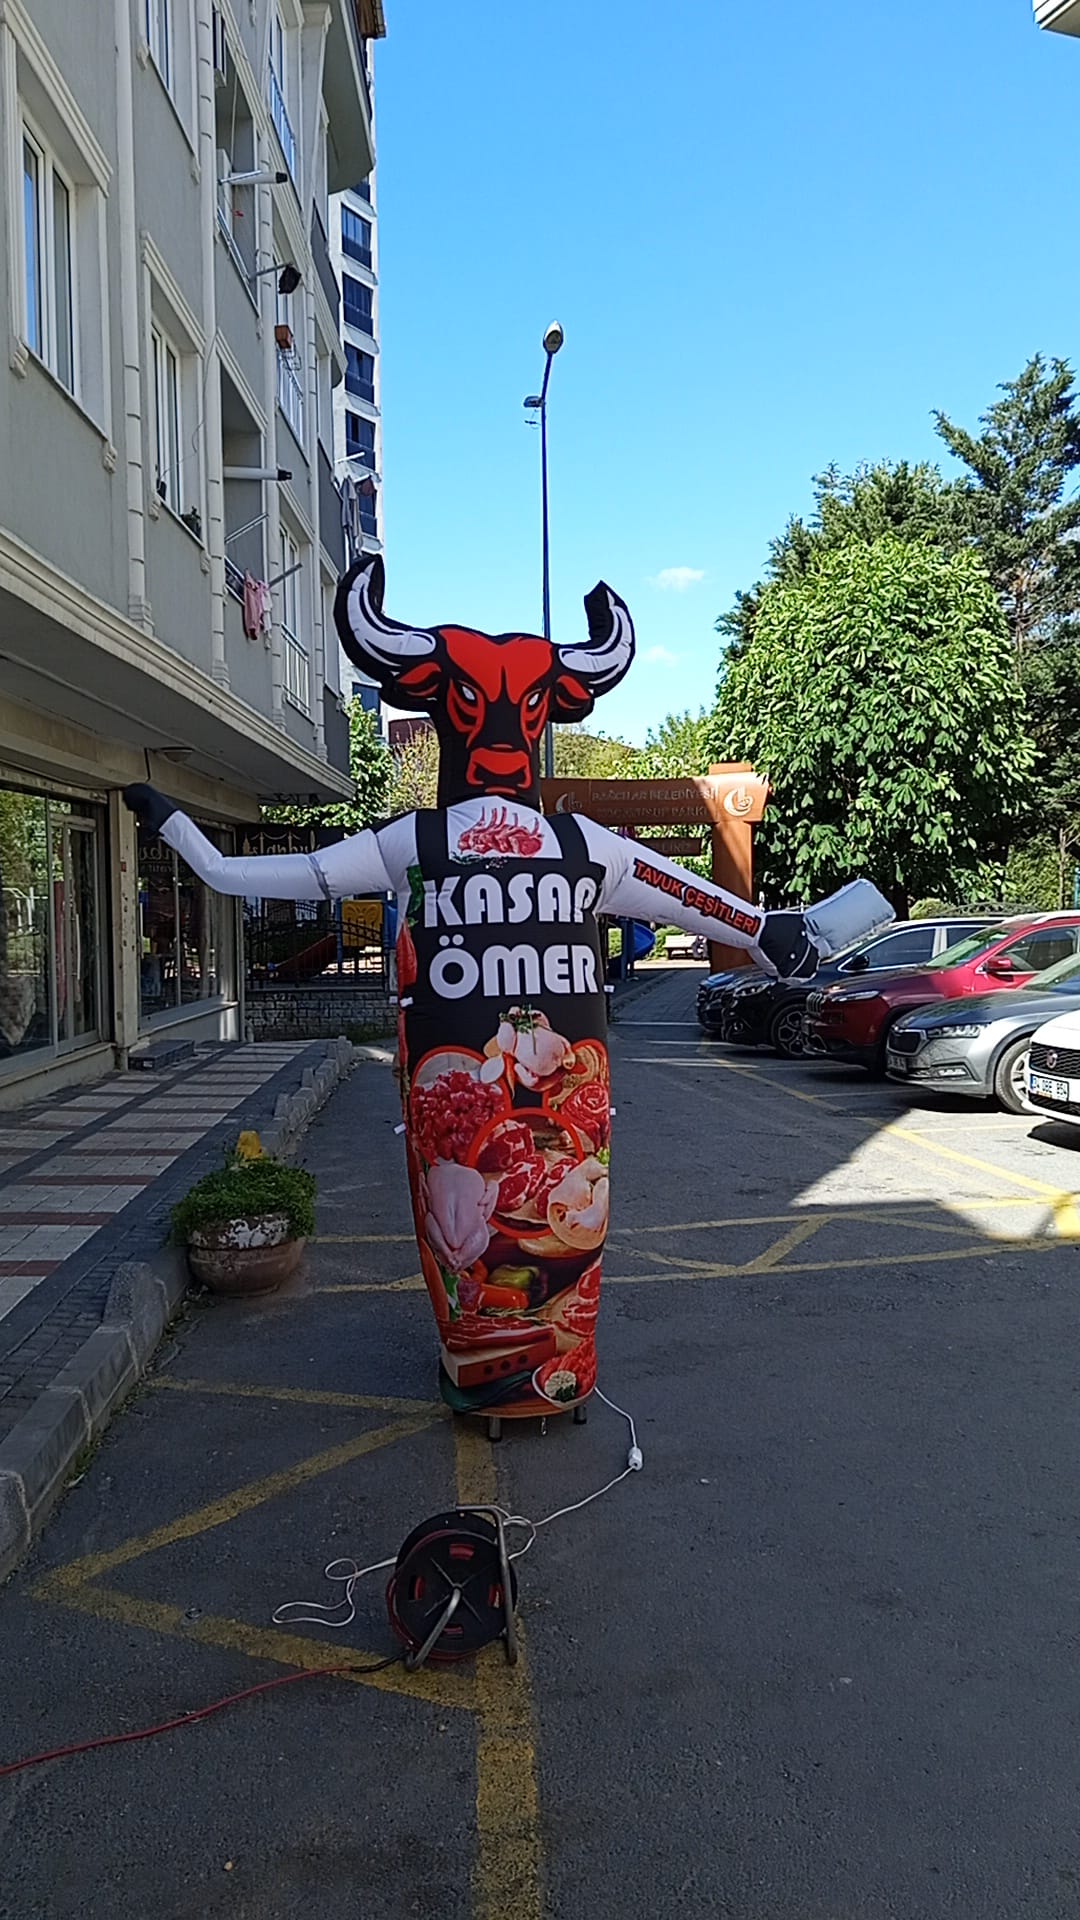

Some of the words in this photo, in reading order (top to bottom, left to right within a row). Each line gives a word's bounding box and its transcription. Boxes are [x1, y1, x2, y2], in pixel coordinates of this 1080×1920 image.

[423, 873, 598, 928] KASAP
[633, 858, 687, 900] TAVUK
[429, 934, 599, 999] ÖMER
